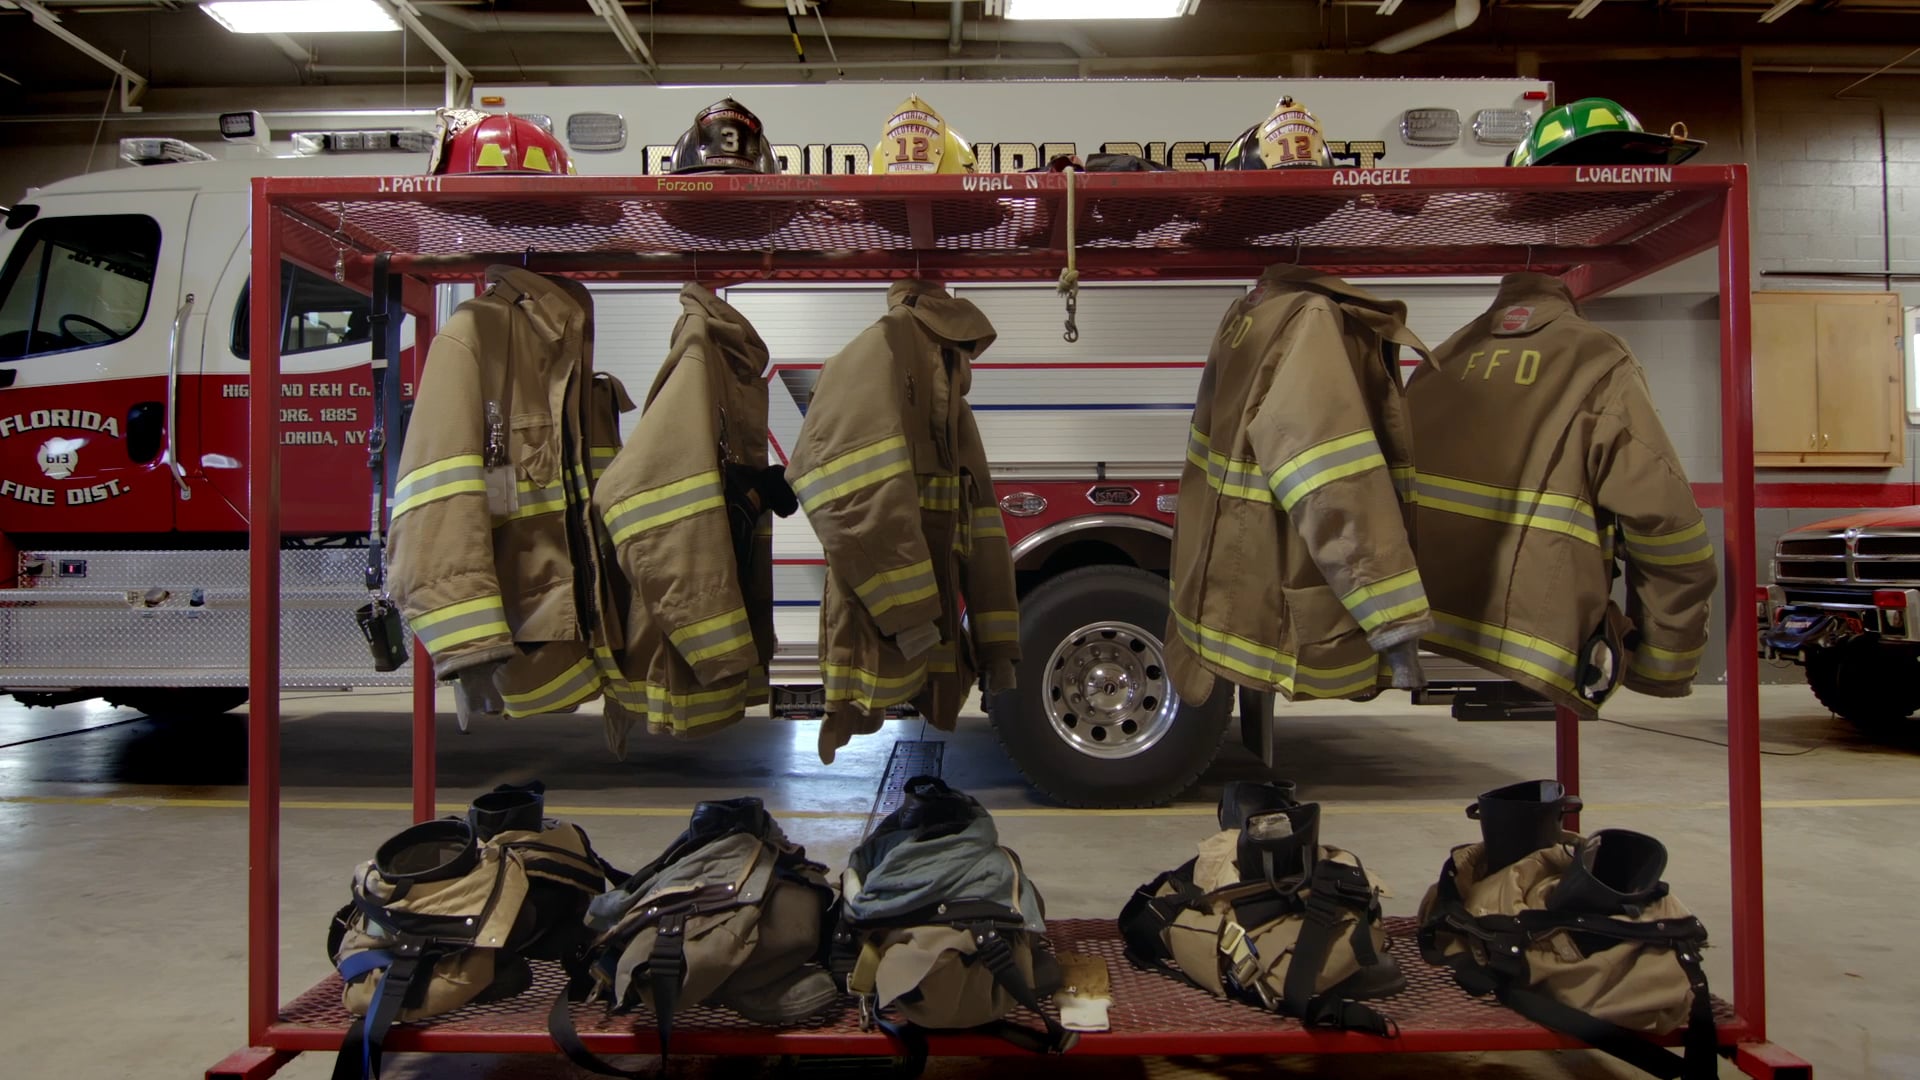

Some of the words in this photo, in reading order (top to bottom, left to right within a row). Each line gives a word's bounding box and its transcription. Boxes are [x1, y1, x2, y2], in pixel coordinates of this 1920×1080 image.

[898, 111, 928, 122] FLORIDA
[889, 124, 936, 138] LIEUTENANT
[720, 127, 739, 153] 3
[895, 137, 929, 162] 12
[1278, 136, 1311, 161] 12
[894, 164, 924, 172] WHALEN
[1576, 167, 1672, 183] L.VALENTIN
[657, 179, 713, 191] Forzono
[1332, 169, 1411, 186] A.DAGELE
[309, 383, 343, 397] E&H
[350, 383, 371, 397] Co.
[320, 408, 358, 422] 1885
[0, 409, 119, 438] FLORIDA
[280, 430, 339, 446] LORIDA,
[345, 430, 367, 445] NY
[46, 452, 69, 464] 613
[0, 479, 55, 505] FIRE
[66, 479, 130, 505] DIST.
